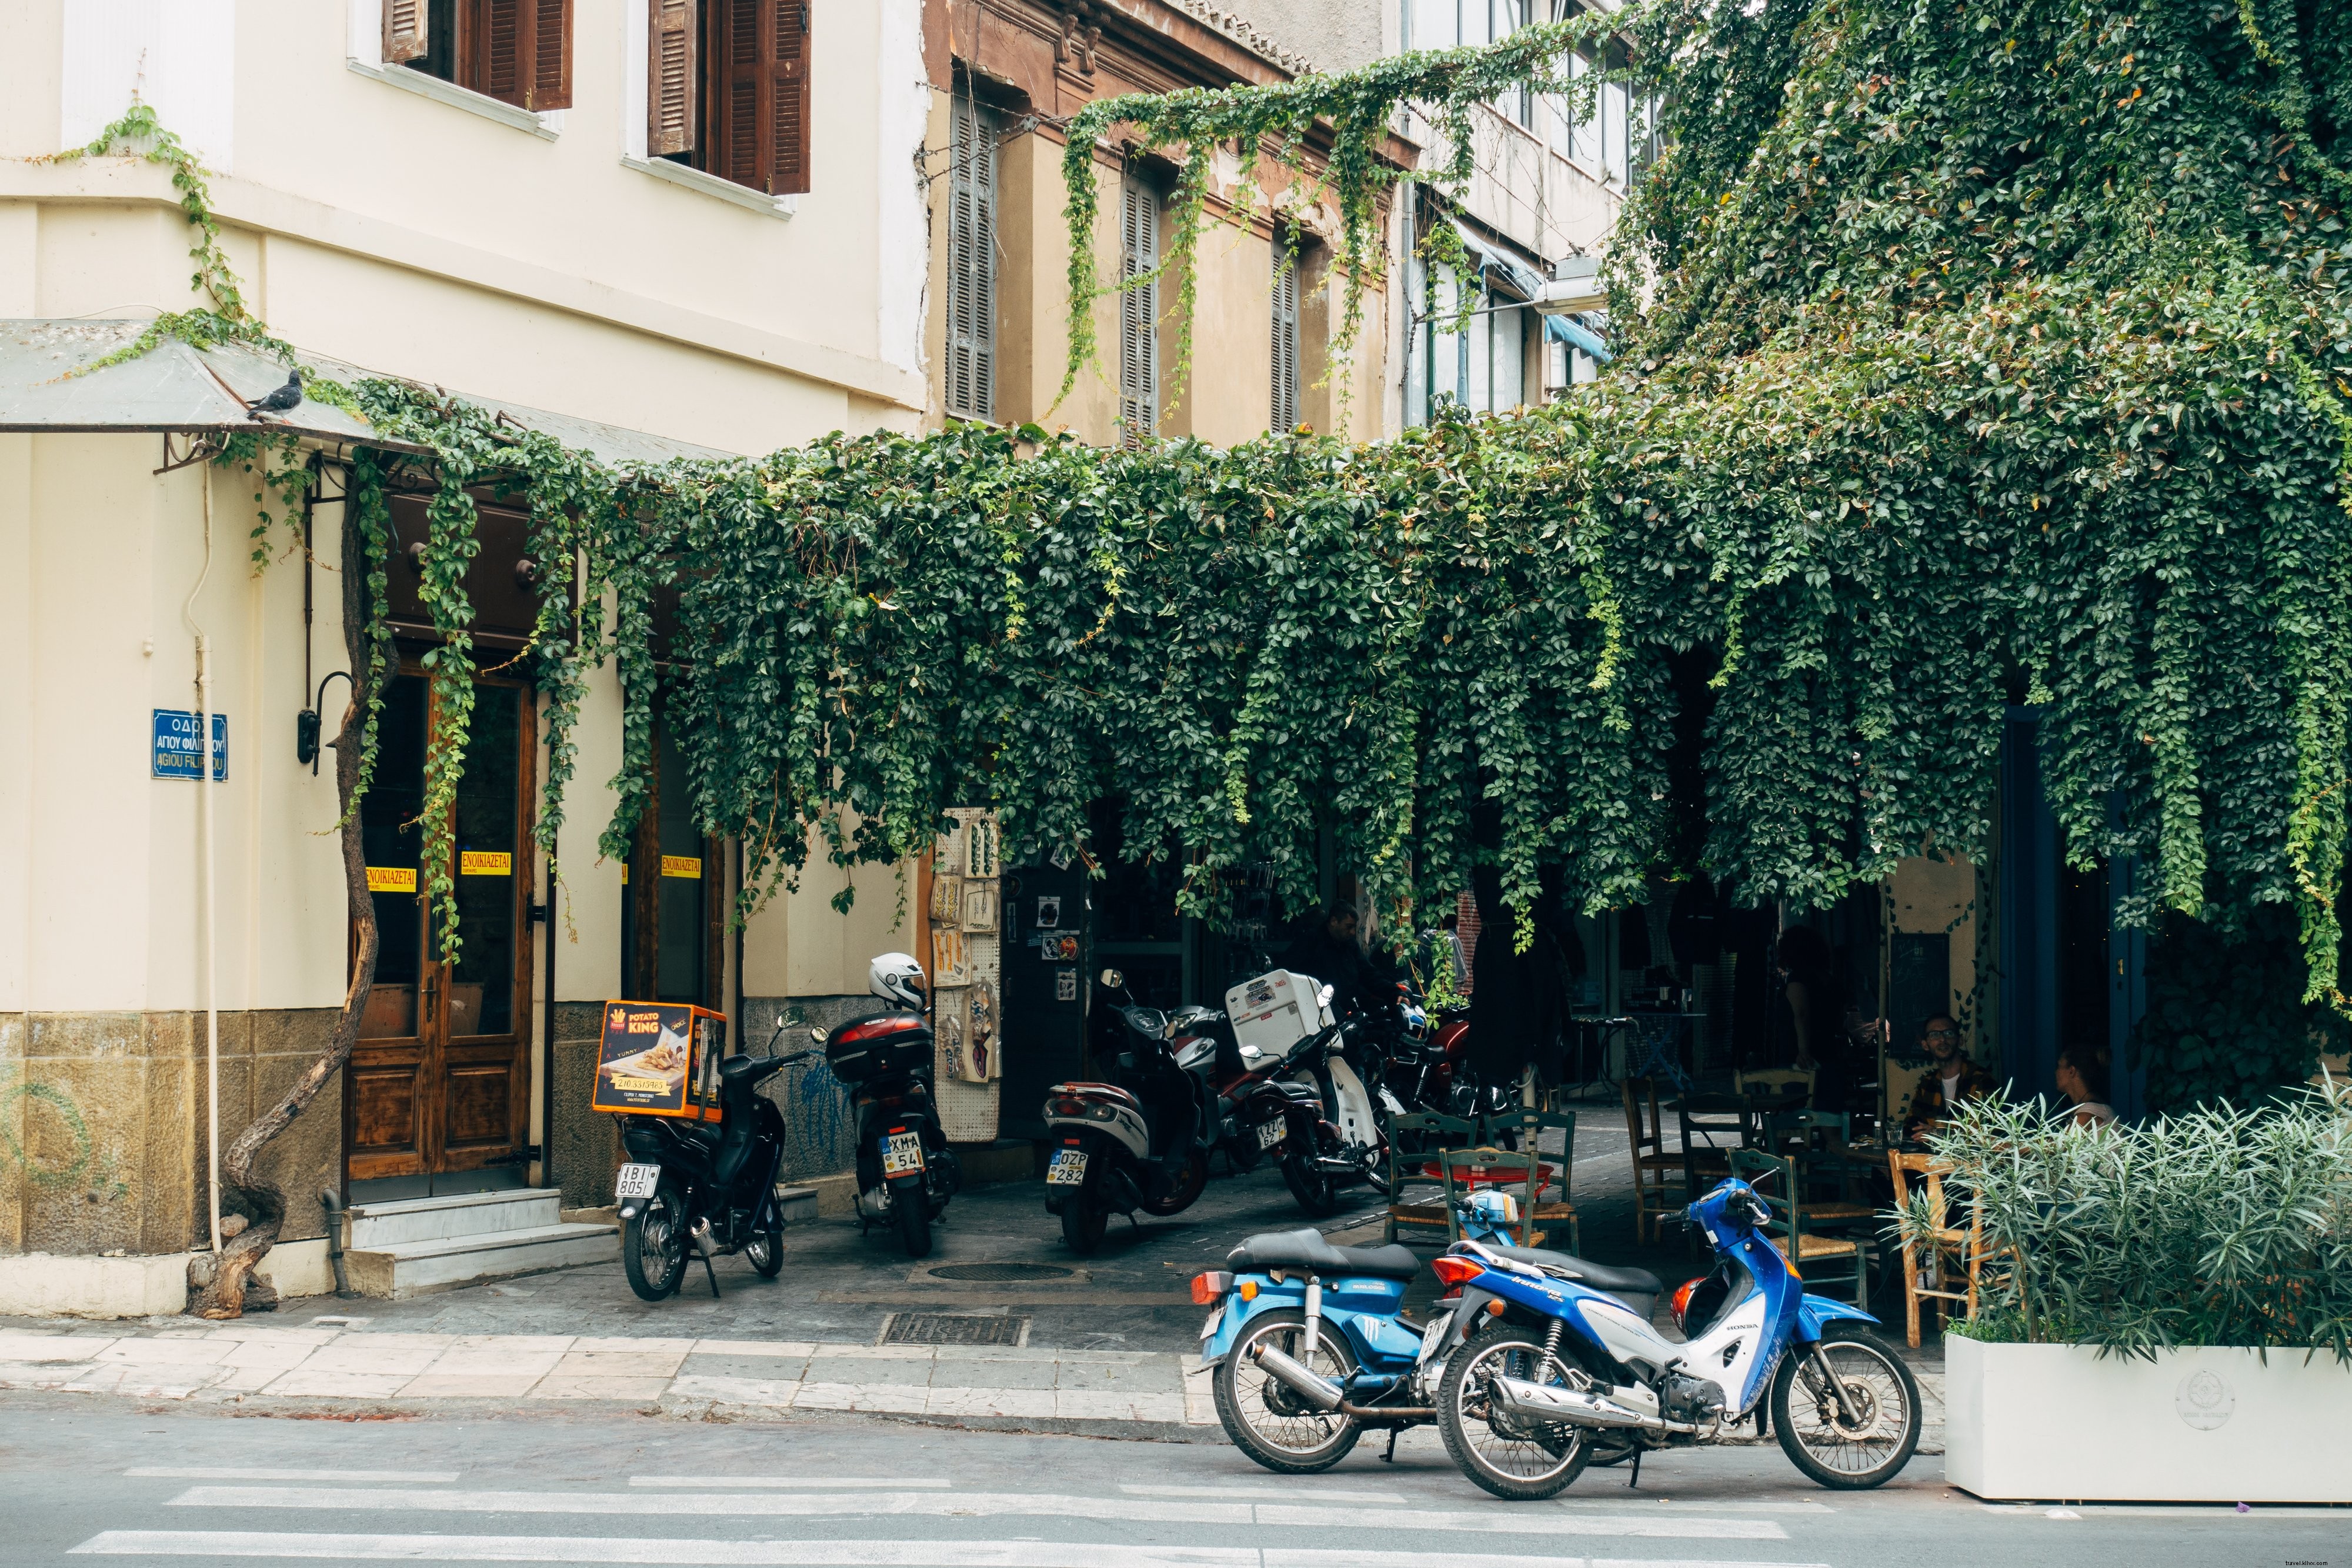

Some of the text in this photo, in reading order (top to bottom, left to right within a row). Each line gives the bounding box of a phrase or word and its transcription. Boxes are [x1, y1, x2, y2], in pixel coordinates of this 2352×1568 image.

[172, 719, 204, 733] ΟΔΟ
[157, 735, 181, 749] ΑΓΙΟΥ
[157, 753, 223, 770] AGIOU FILIPOU
[463, 854, 509, 868] ΕΝΟΙΚΙΑΖΕΤΑΙ
[662, 857, 700, 872] ΕΝΟΙΚΙΑΖΕΤΑΙ
[629, 1012, 659, 1022] POTATO
[628, 1022, 659, 1034] KING
[671, 1018, 686, 1030] CHOICE
[945, 1049, 954, 1079] LEAD
[618, 1079, 663, 1089] 210.3315985
[891, 1136, 919, 1152] XMA
[1264, 1133, 1275, 1146] 62
[898, 1153, 916, 1166] 54
[1060, 1153, 1087, 1166] OZP
[1056, 1169, 1083, 1182] 282
[620, 1180, 644, 1194] 805
